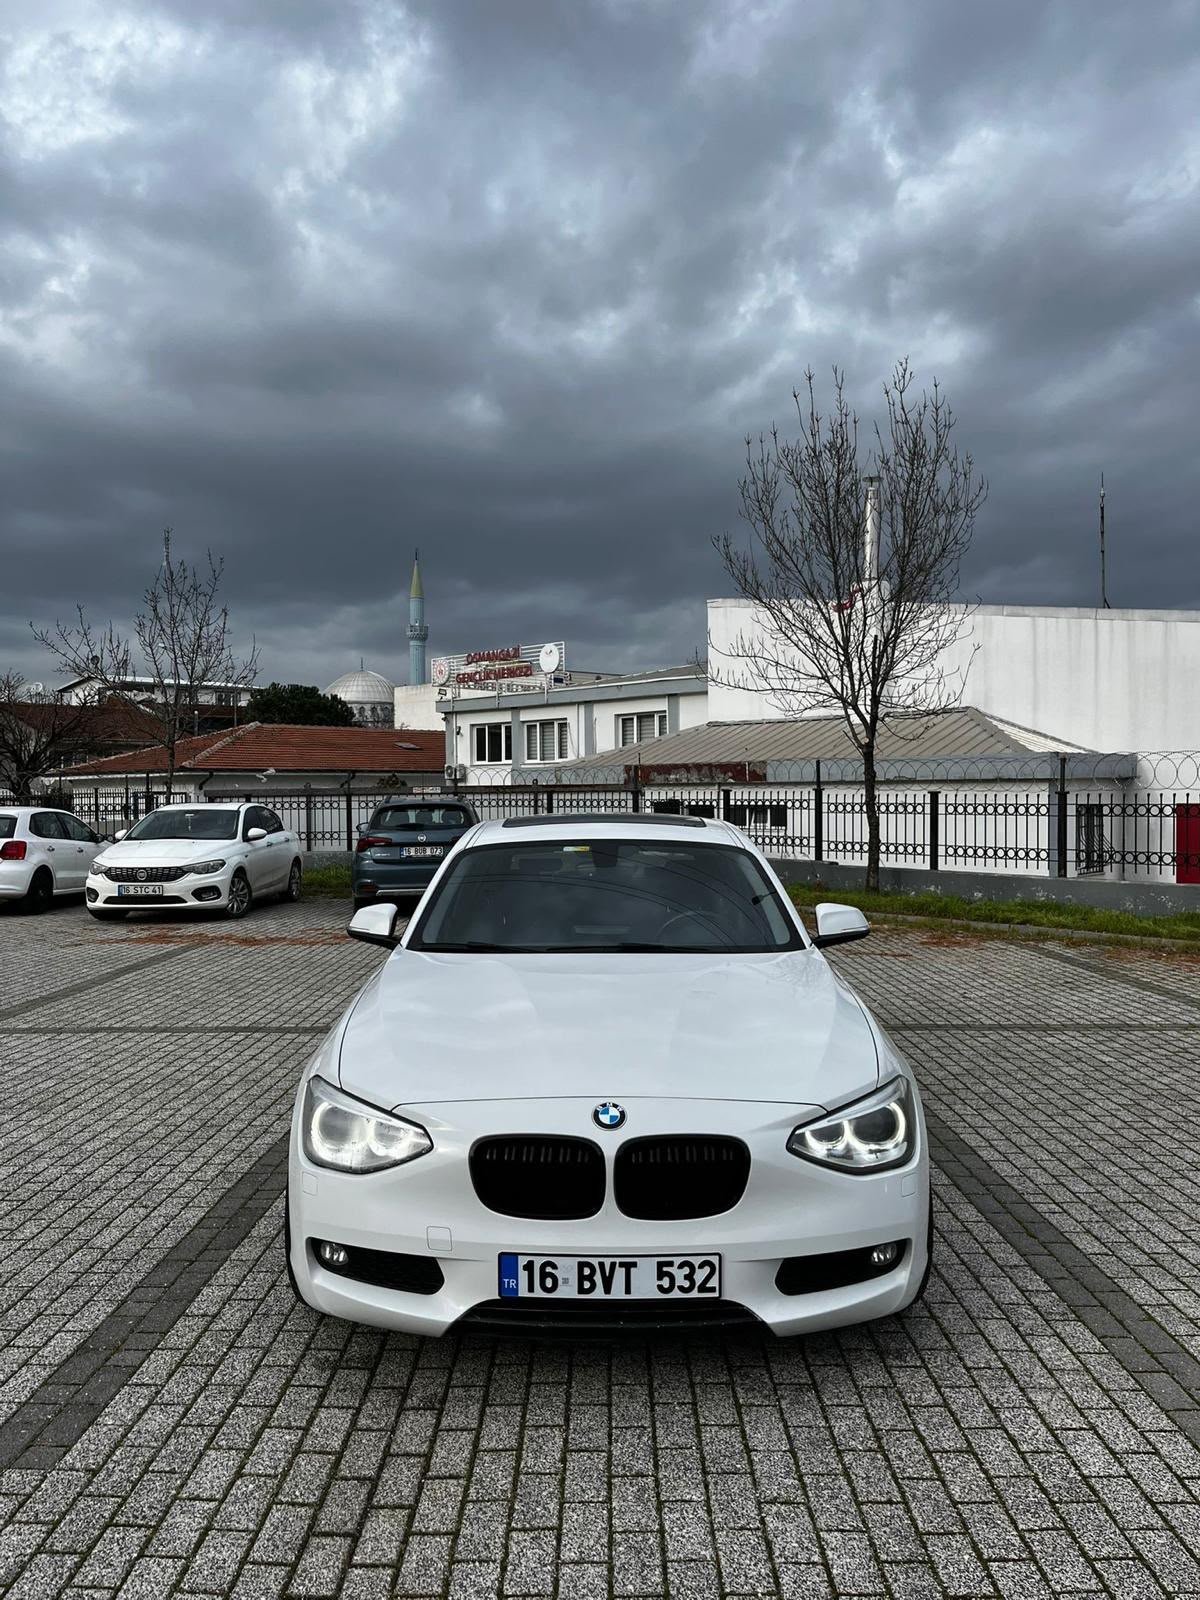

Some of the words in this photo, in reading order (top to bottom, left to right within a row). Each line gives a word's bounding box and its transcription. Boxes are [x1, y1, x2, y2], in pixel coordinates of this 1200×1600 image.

[123, 886, 131, 894] 16
[133, 886, 150, 894] STC
[152, 886, 161, 894] 41
[503, 1279, 517, 1289] TR
[522, 1259, 558, 1294] 16
[577, 1260, 638, 1295] BVT
[656, 1259, 717, 1295] 532
